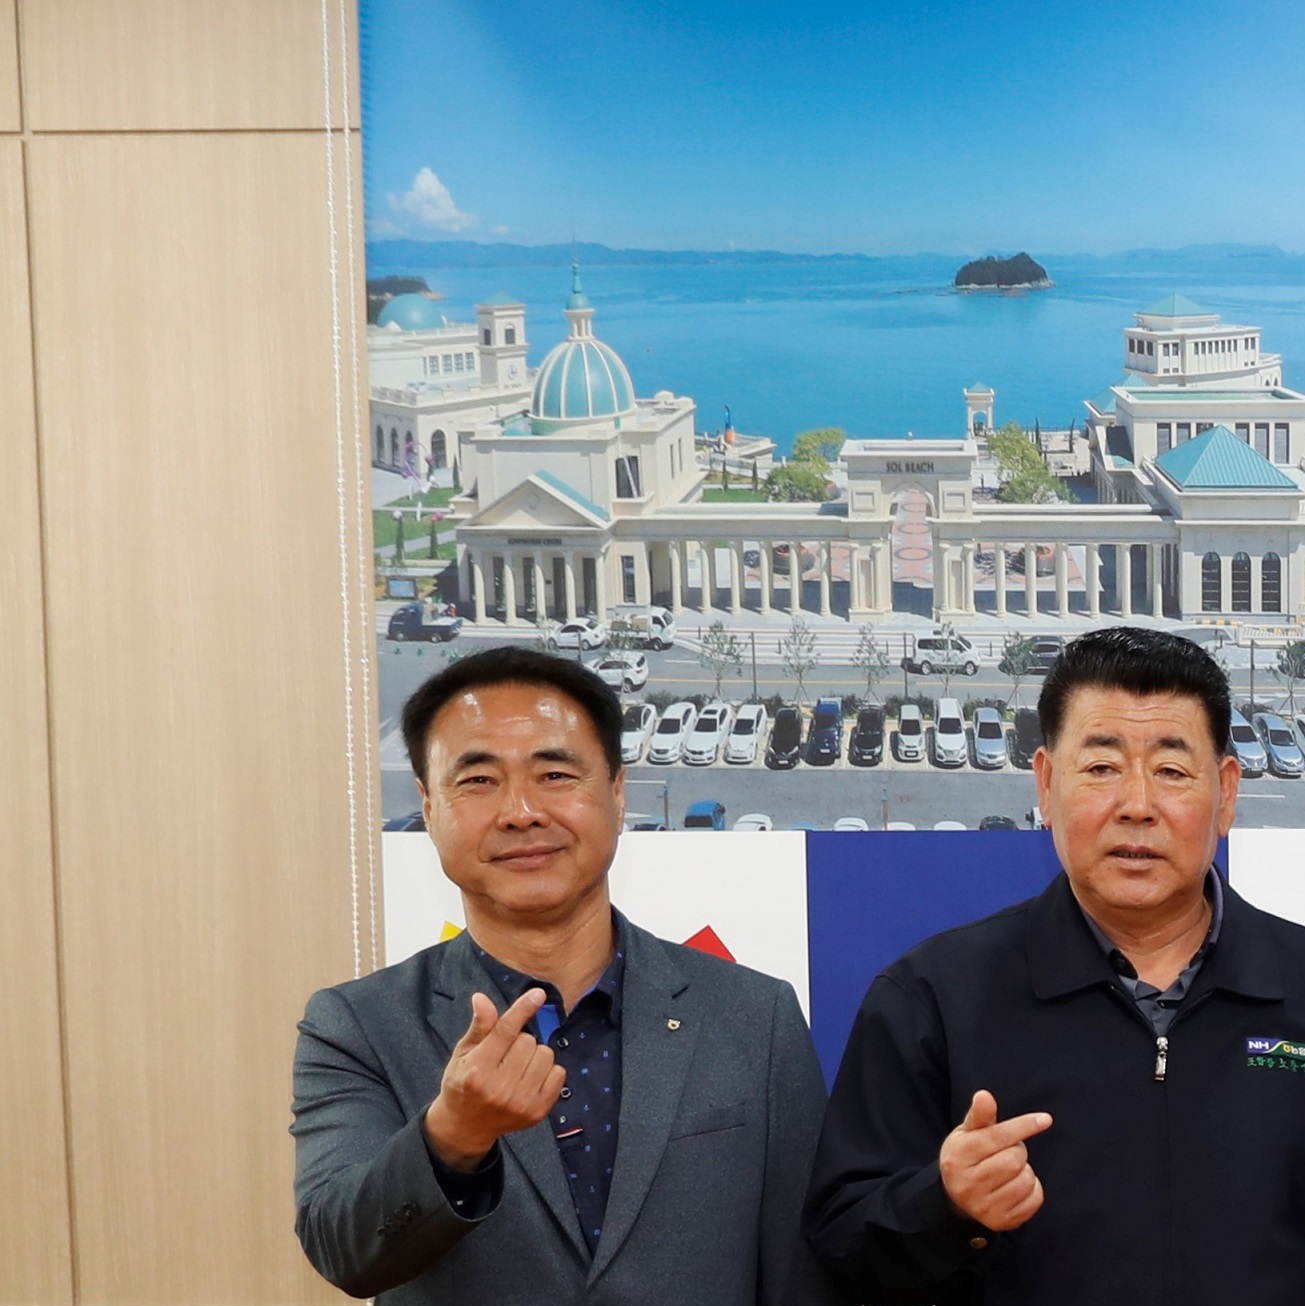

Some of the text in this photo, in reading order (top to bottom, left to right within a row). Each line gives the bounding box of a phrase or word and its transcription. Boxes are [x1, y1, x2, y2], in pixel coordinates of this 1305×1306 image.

[886, 462, 935, 473] SOL BEACH
[1248, 1040, 1270, 1050] NH
